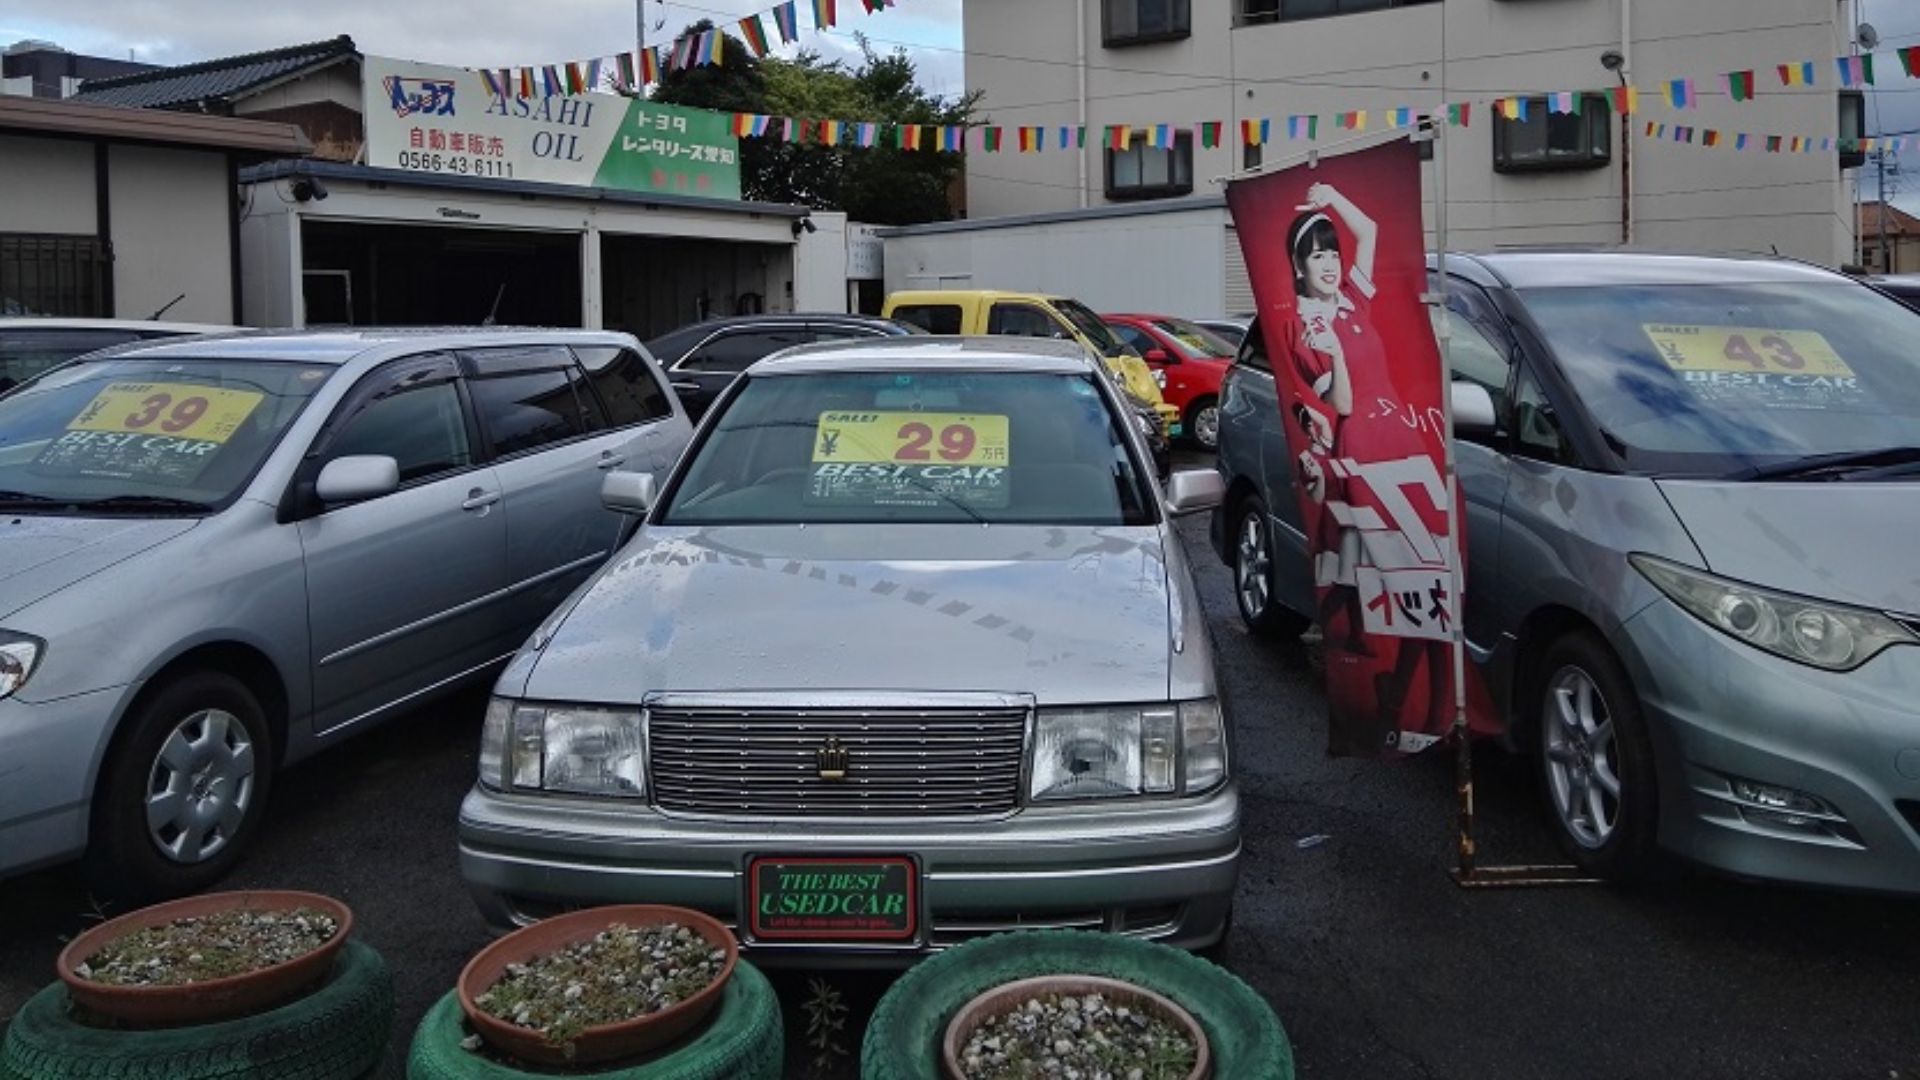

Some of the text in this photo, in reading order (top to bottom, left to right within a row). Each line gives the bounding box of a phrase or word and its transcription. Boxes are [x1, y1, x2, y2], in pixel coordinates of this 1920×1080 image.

[485, 92, 595, 128] ASAHI
[638, 110, 687, 134] トヨタ
[409, 126, 505, 158] 自動車販売
[532, 131, 585, 162] OIL
[622, 135, 735, 165] レンタリース愛知
[1723, 333, 1806, 370] 43
[1684, 371, 1858, 389] BEST CAR
[124, 392, 209, 433] 39
[59, 431, 137, 446] BEST
[142, 436, 219, 456] CAR
[894, 421, 976, 462] 29
[814, 463, 1005, 479] BEST CAR
[779, 873, 884, 890] THE BEST
[761, 893, 904, 915] USED CAR
